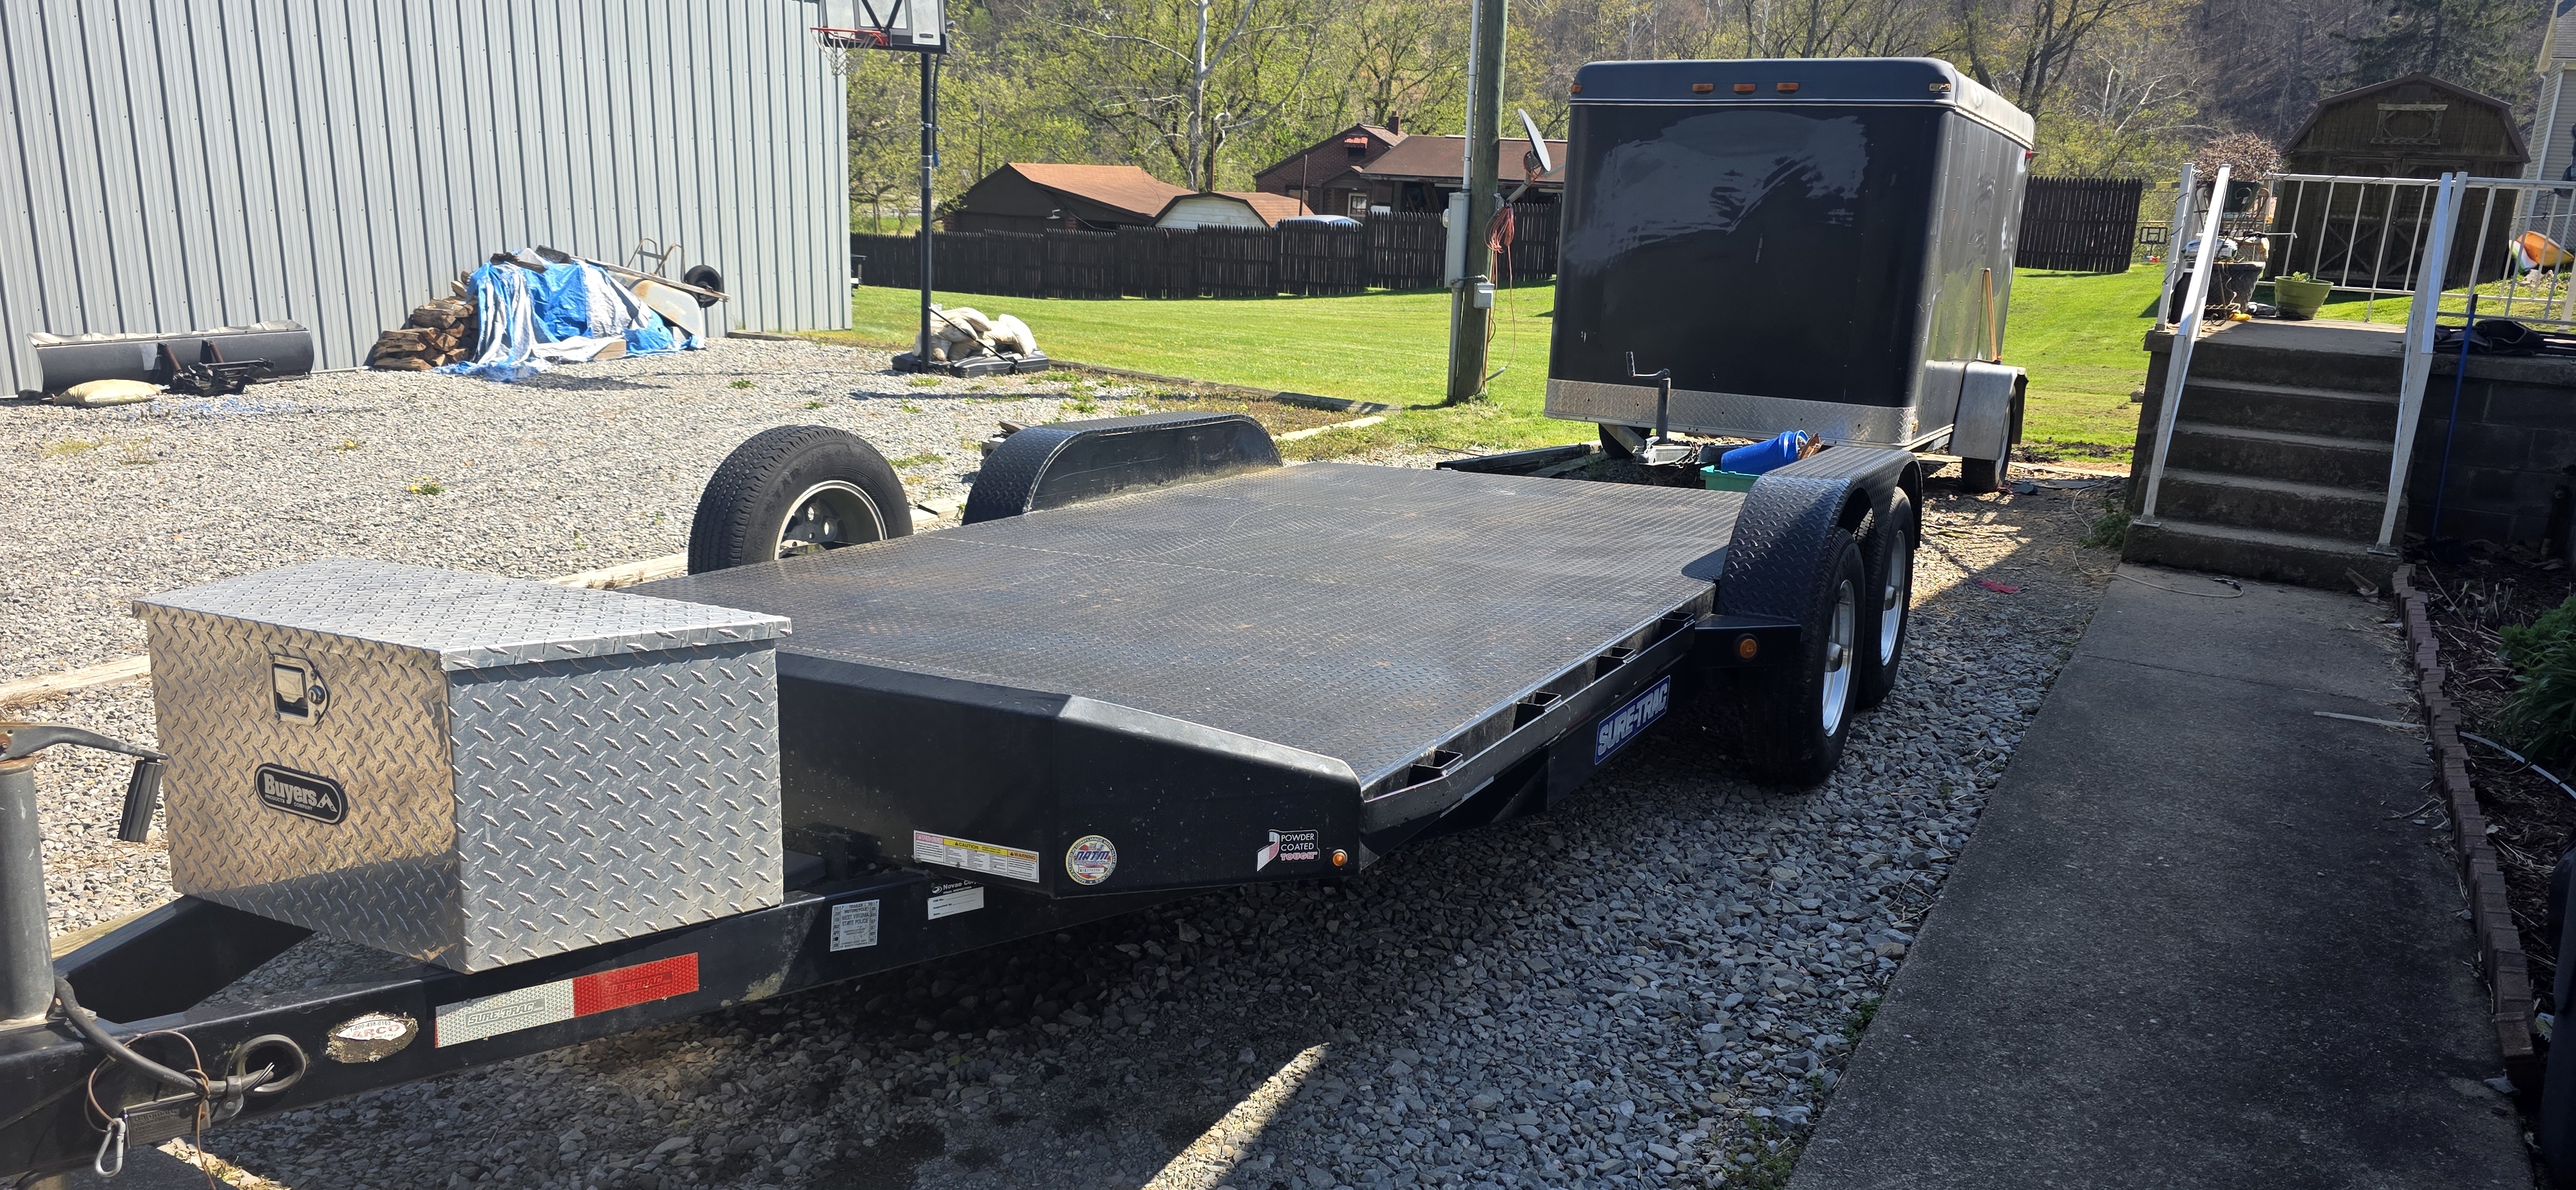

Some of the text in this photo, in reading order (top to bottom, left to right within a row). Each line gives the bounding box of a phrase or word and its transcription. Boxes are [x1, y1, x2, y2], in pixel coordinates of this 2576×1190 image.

[1597, 683, 1668, 756] SURE-TRAC
[263, 773, 317, 806] Buyers
[265, 794, 313, 811] PRODUCTS COMPANY
[1075, 837, 1103, 848] COMPLIANCE
[1103, 840, 1113, 850] WITH
[1281, 833, 1314, 842] POWDER
[959, 842, 979, 850] CAUTION
[1281, 843, 1314, 851] COATED
[1014, 852, 1036, 860] WARNING
[601, 975, 663, 997] SURE-TRAC
[467, 1002, 535, 1026] SURE-TRAC
